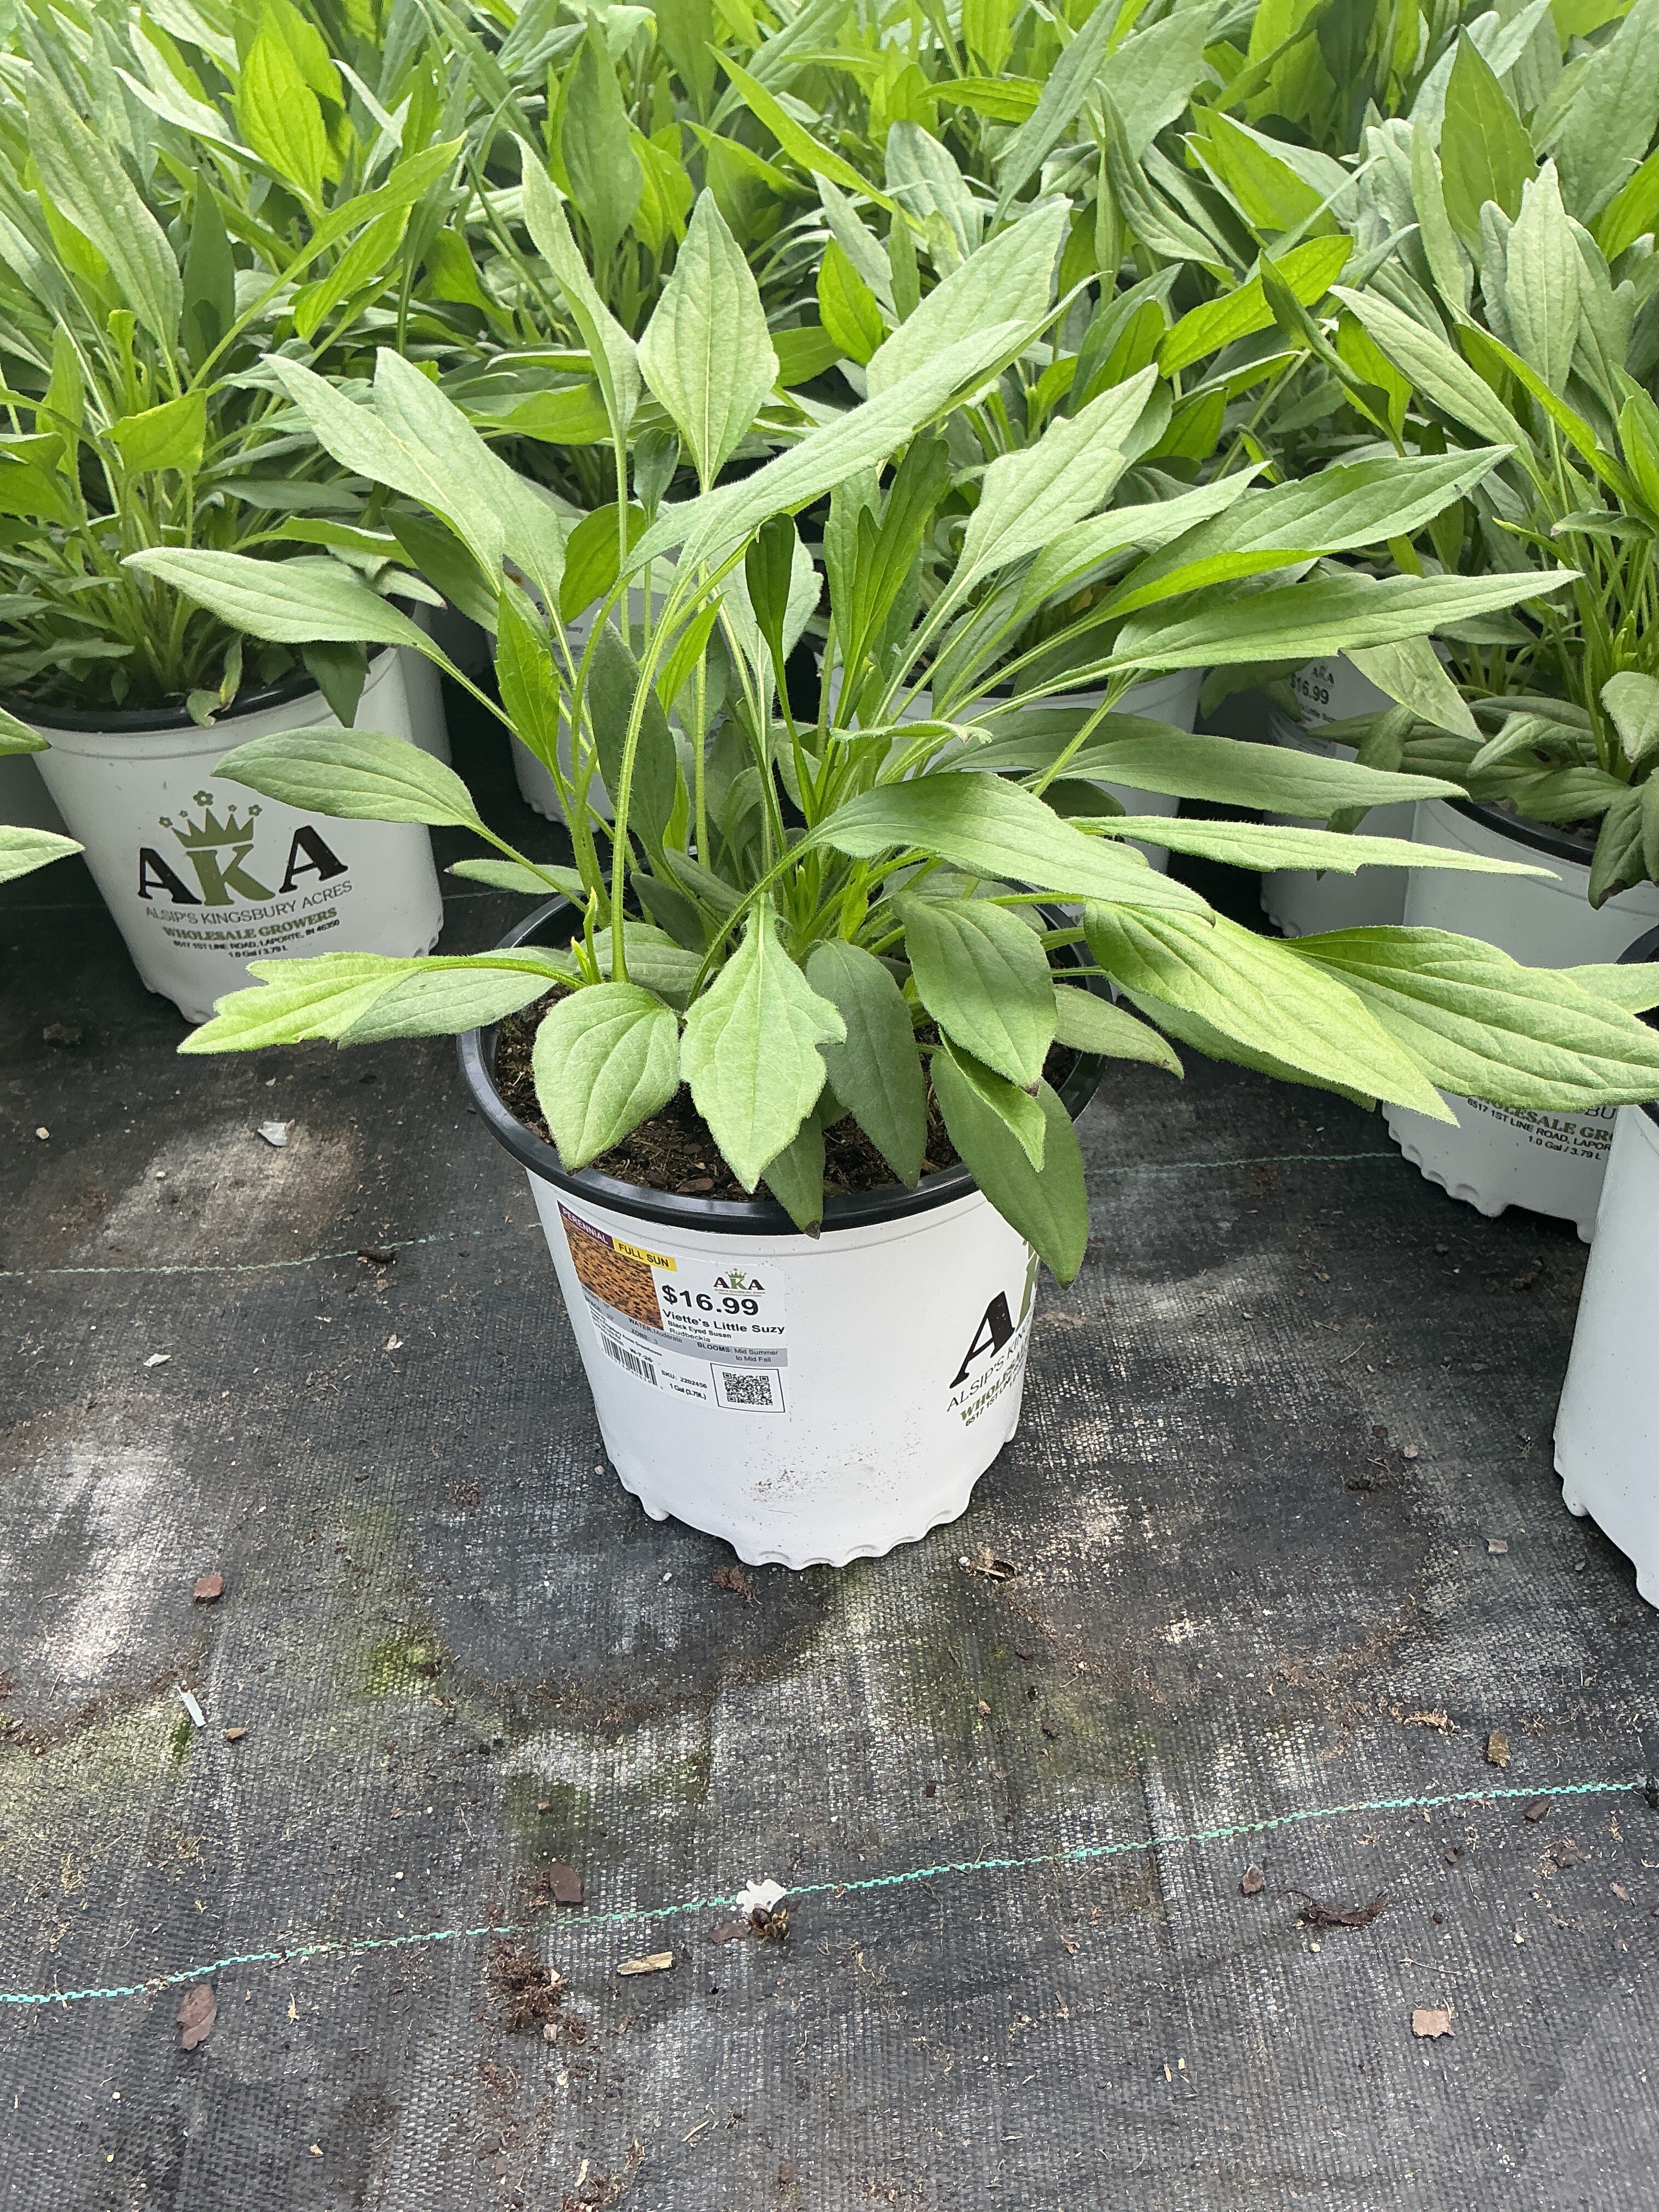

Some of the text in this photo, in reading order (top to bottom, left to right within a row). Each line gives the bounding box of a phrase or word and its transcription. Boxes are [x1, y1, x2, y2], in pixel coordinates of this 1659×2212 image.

[137, 825, 349, 906] AKA
[146, 880, 352, 924] ALSIP'S KINGSBURY ACRES
[162, 907, 337, 940] WHOLESALE GROWERS
[1467, 1098, 1488, 1113] 6517
[1491, 1110, 1509, 1122] 1ST
[1510, 1118, 1534, 1133] LINE
[1536, 1127, 1570, 1144] ROAD,
[1528, 1135, 1543, 1146] 1.0
[1544, 1141, 1563, 1152] Gal
[1570, 1147, 1594, 1158] 3.79
[1595, 1151, 1602, 1160] L
[562, 1207, 609, 1245] PERENNIAL
[618, 1243, 669, 1268] FULL SUN
[713, 1276, 766, 1291] AKA
[661, 1284, 759, 1316] $16.99
[662, 1308, 785, 1335] Viette's Little Suzy
[667, 1320, 732, 1339] Black Eyed Susan
[669, 1328, 711, 1343] Rudbeckia
[697, 1341, 732, 1353] BLOOMS:
[661, 1369, 678, 1380] SKU:
[946, 1355, 1005, 1412] ALSIP'S
